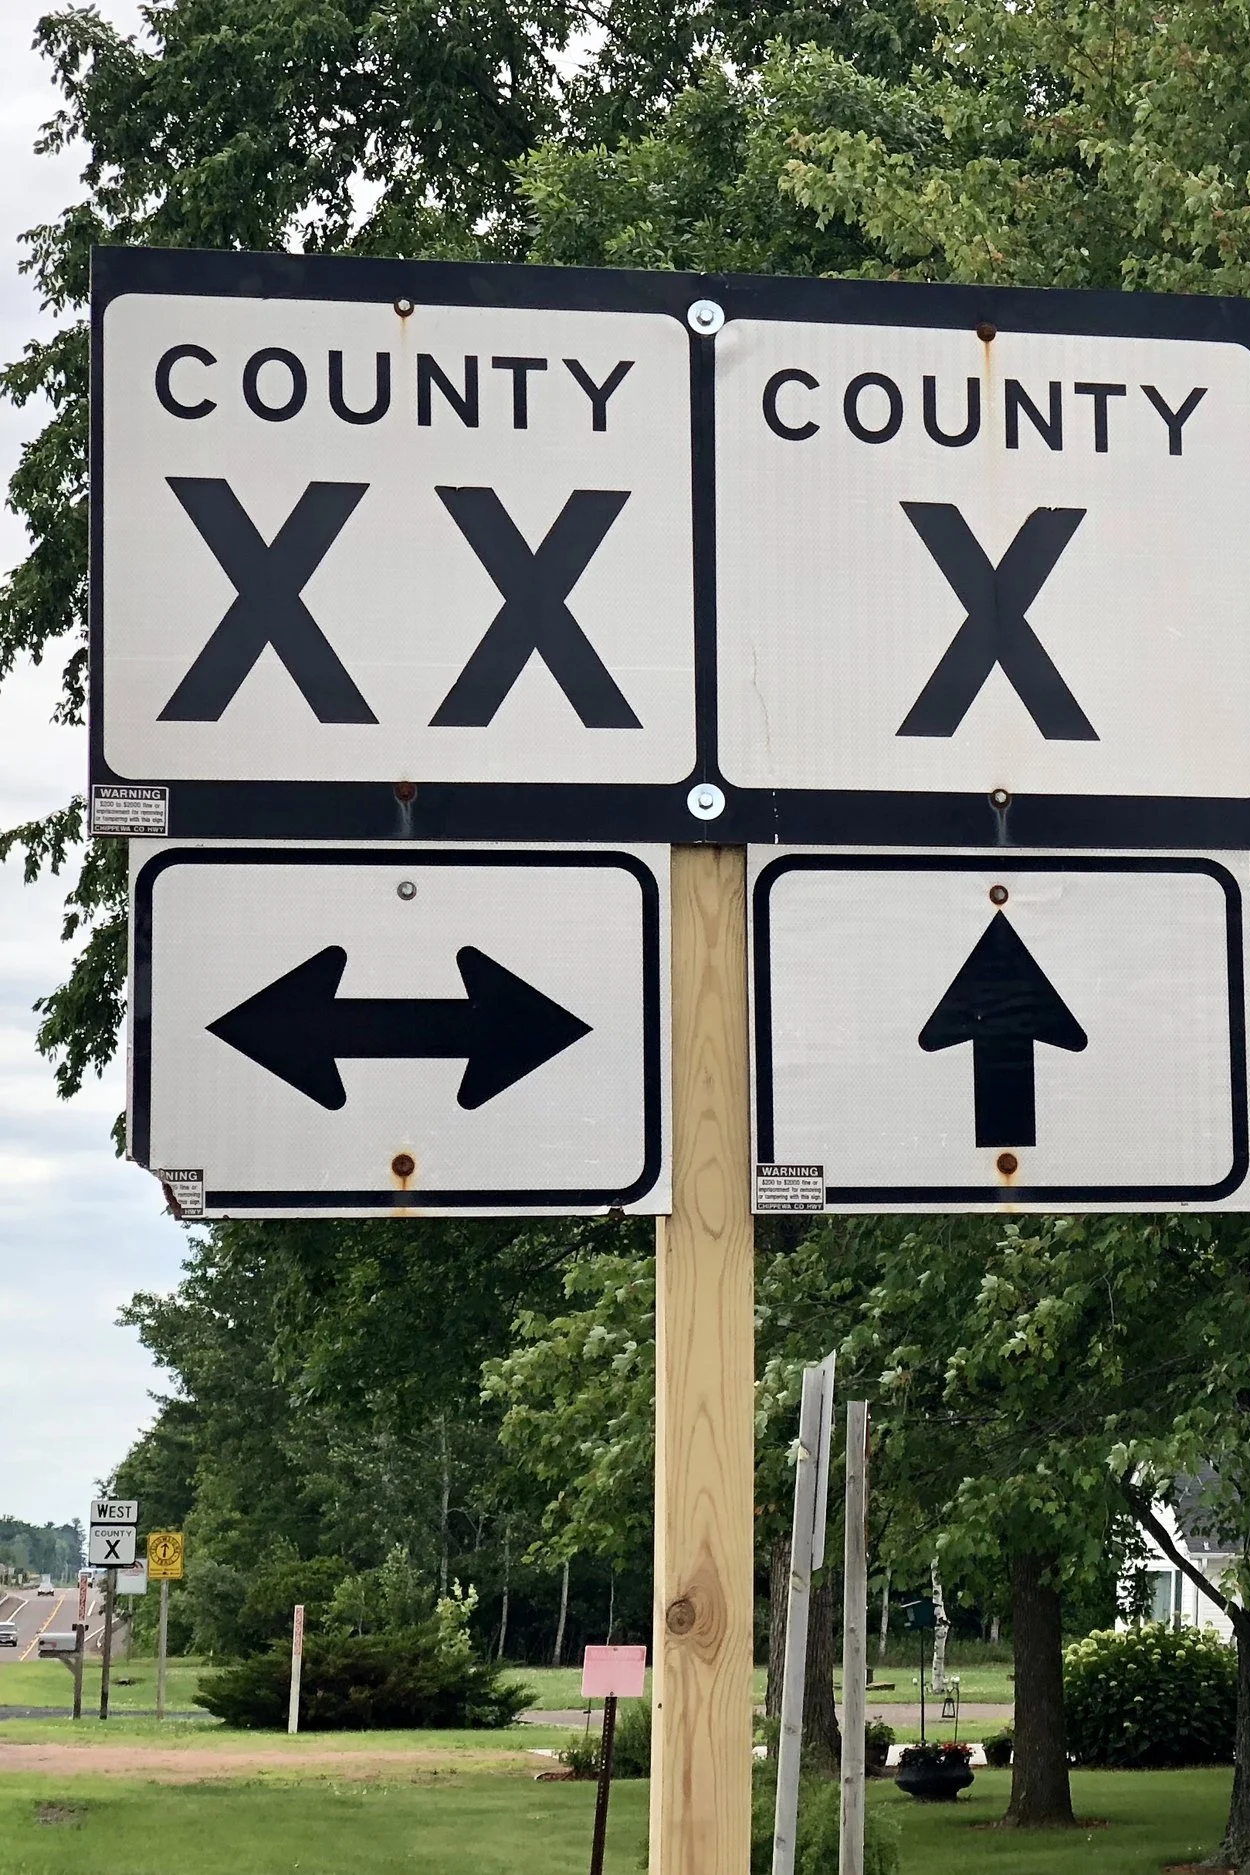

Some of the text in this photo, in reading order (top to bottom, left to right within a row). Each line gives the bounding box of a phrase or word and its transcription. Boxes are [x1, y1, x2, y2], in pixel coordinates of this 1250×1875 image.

[155, 343, 636, 432] COUNTY
[762, 368, 1209, 456] COUNTY
[155, 476, 644, 730] XX
[894, 500, 1101, 741] X
[100, 788, 161, 800] WARNING
[762, 1166, 819, 1177] WARNING
[97, 1504, 132, 1519] WEST
[94, 1529, 132, 1538] COUNTY
[103, 1539, 121, 1560] X
